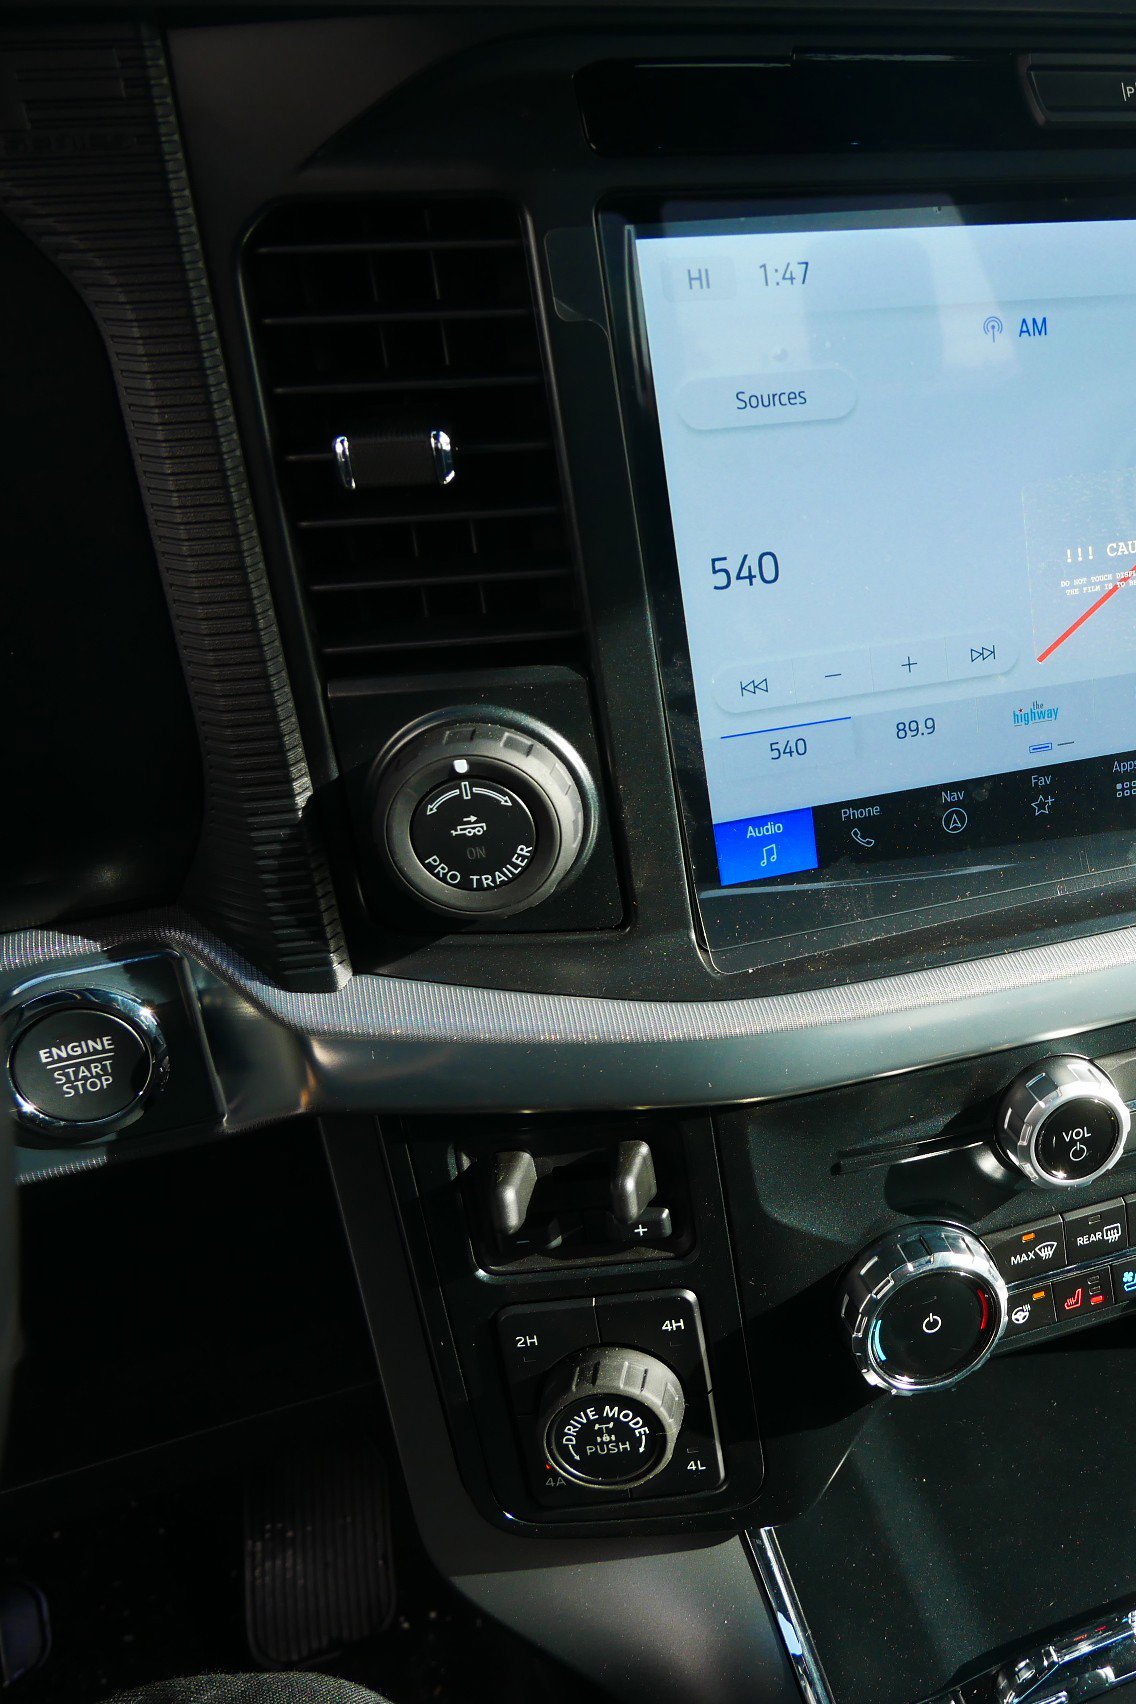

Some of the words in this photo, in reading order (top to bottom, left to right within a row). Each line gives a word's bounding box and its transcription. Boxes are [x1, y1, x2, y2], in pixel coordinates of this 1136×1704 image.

[687, 268, 711, 290] HI
[759, 261, 810, 288] 1:47
[1018, 316, 1049, 338] AM
[735, 389, 807, 411] Sources
[710, 551, 780, 591] 540
[1061, 580, 1070, 588] DO
[1074, 578, 1087, 586] NOT
[1091, 574, 1112, 583] TOUCH
[1066, 588, 1079, 596] THE
[1083, 585, 1101, 594] FILM
[1116, 580, 1126, 589] TO
[1033, 700, 1043, 709] the
[1013, 707, 1058, 726] highway
[896, 718, 936, 740] 89.9
[770, 738, 808, 761] 540
[1031, 773, 1052, 787] Fav
[941, 788, 965, 803] Nav
[841, 803, 880, 821] Phone
[746, 820, 783, 839] Audio
[466, 846, 487, 861] ON
[424, 855, 461, 884] PRO
[470, 843, 533, 889] TRAILER
[39, 1036, 115, 1064] ENGINE
[53, 1060, 113, 1085] START
[62, 1075, 113, 1098] STOP
[1062, 1126, 1091, 1142] VOL
[1077, 1232, 1103, 1246] REAR
[1010, 1249, 1035, 1266] MAX
[661, 1318, 685, 1332] 4H
[515, 1335, 538, 1348] 2H
[563, 1407, 599, 1445] DRIVE
[603, 1405, 649, 1437] MODE
[586, 1441, 631, 1456] PUSH
[687, 1460, 706, 1471] 4L
[545, 1477, 567, 1488] 4A
